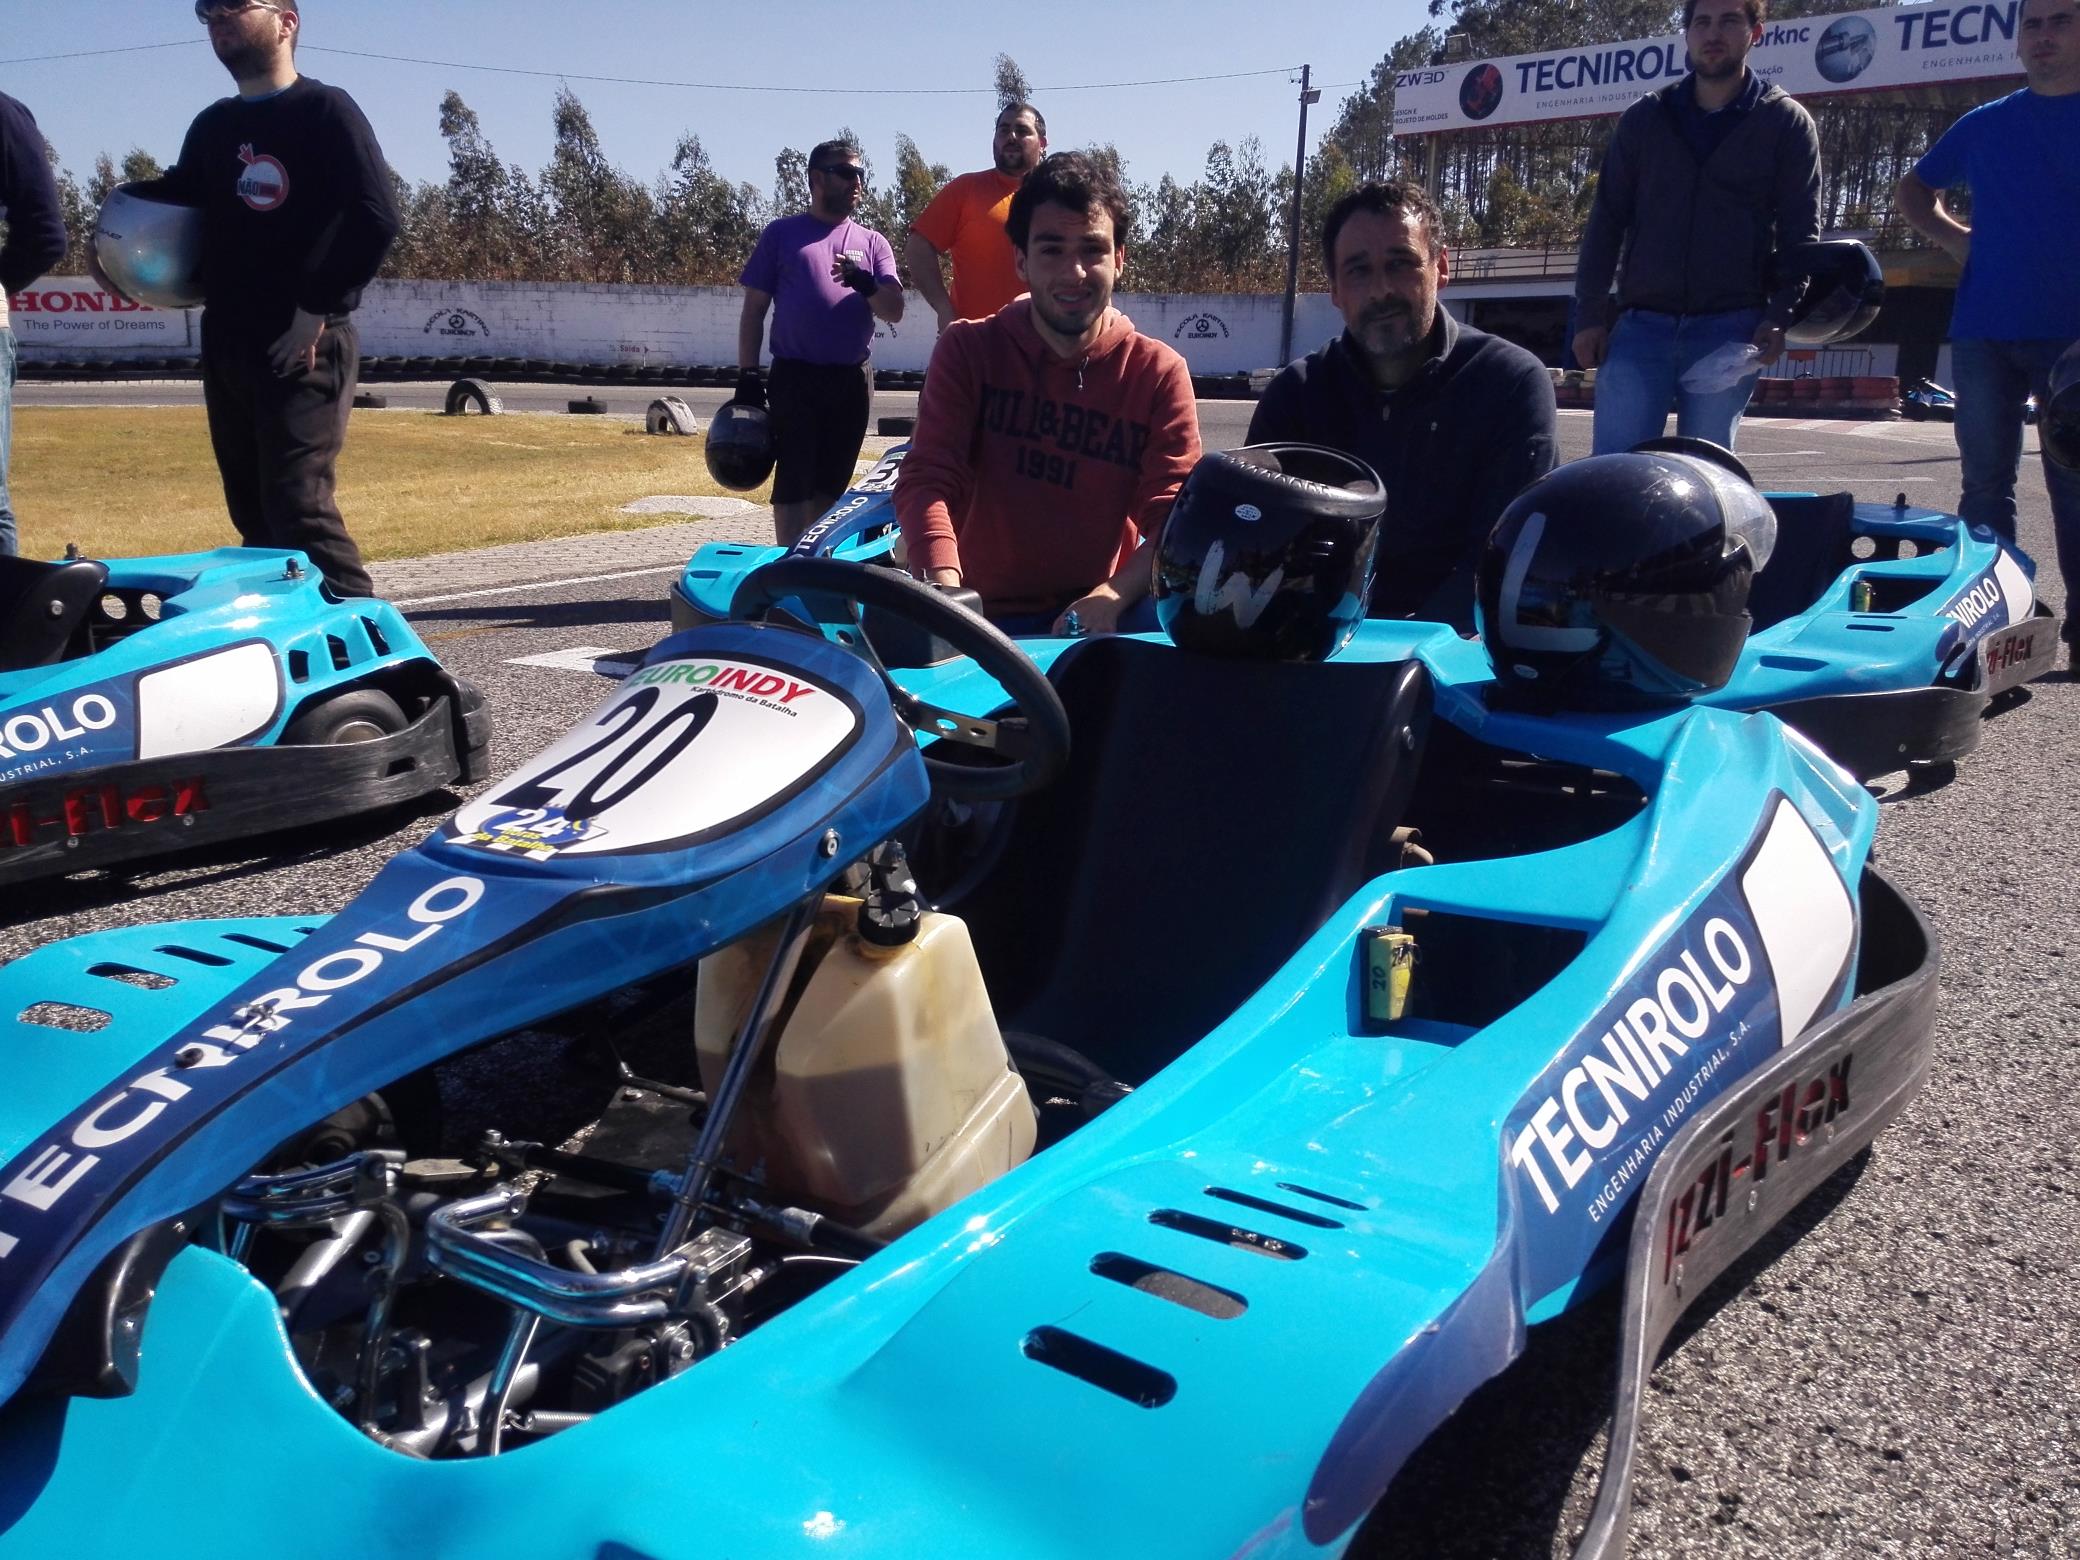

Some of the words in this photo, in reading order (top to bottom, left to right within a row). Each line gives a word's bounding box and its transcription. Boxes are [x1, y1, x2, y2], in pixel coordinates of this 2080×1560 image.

[1894, 1, 2018, 51] TECN
[1516, 43, 1692, 94] TECNIROL
[1922, 53, 2003, 70] ENGENHARIA
[1425, 112, 1449, 121] MOLDES
[1536, 95, 1594, 109] ENGENHARIA
[9, 291, 160, 312] HOND
[24, 319, 49, 330] The
[54, 320, 94, 330] Power
[99, 319, 110, 330] of
[115, 320, 165, 330] Dreams
[424, 308, 452, 334] ESCOLA
[457, 308, 490, 337] KARTING
[1174, 313, 1199, 338] ESCOLA
[1202, 313, 1230, 338] KARTING
[1015, 446, 1078, 490] 1991
[1194, 539, 1284, 630] W
[1948, 577, 2000, 629] NIROLO
[746, 695, 758, 704] da
[759, 699, 798, 718] Batalha
[65, 746, 94, 760] S.A.
[490, 686, 719, 823] 20
[492, 808, 571, 838] 24
[1371, 965, 1386, 992] 20
[1511, 917, 1751, 1215] TECNIROLO
[1588, 1127, 1663, 1224] ENGENHARIA
[1664, 1048, 1732, 1128] INDUSTRIAL,
[1729, 1022, 1751, 1047] S.A.
